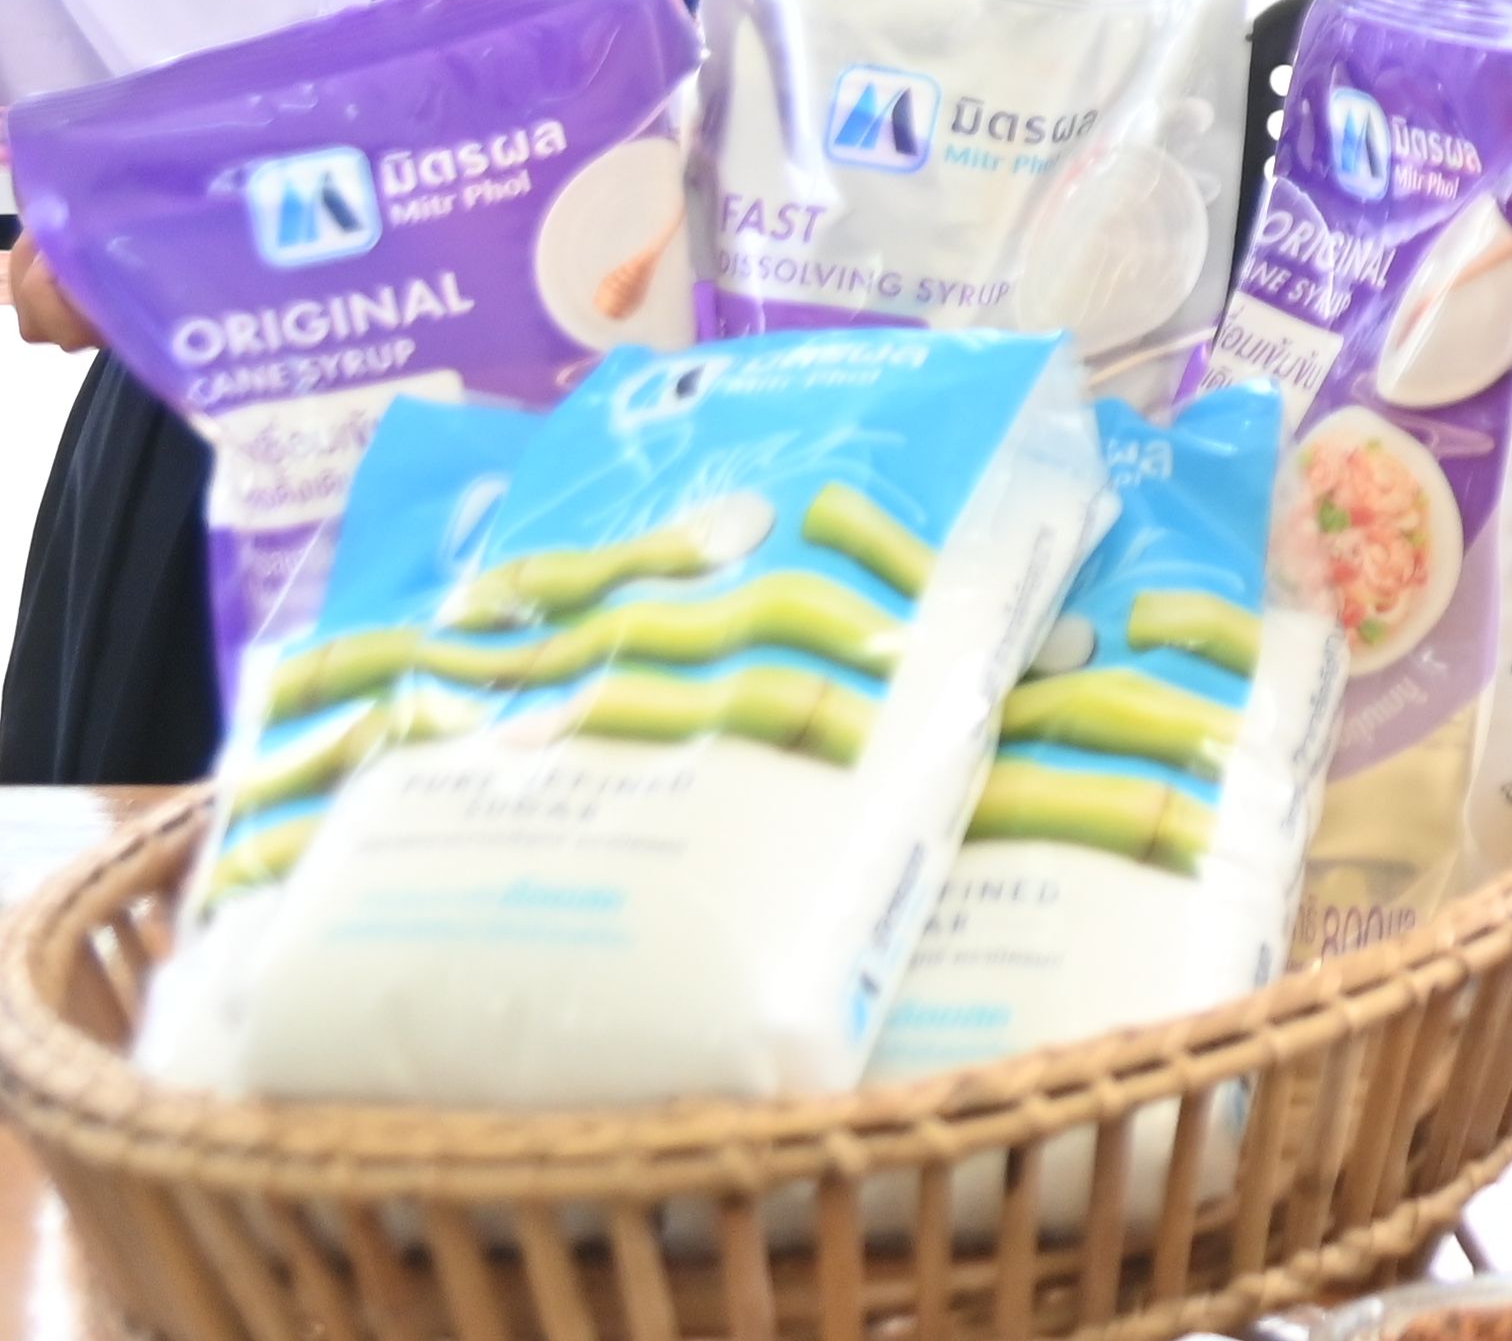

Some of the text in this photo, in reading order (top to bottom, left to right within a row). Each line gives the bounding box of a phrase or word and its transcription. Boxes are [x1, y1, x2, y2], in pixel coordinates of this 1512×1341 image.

[950, 97, 1100, 145] มิตรผล
[1391, 115, 1483, 175] มิตรผล
[379, 119, 568, 201] มิตรผล
[944, 146, 1005, 175] Mitr
[1394, 165, 1460, 200] Mitr Phol
[389, 170, 533, 228] Mitr Phol
[718, 193, 829, 246] FAST
[1260, 210, 1398, 290] ORIGINAL
[718, 251, 1011, 308] DISSOLVING SYRUP
[1288, 270, 1354, 319] SYRUP
[171, 271, 475, 366] ORIGINAL
[186, 338, 417, 406] CANE SYRUP
